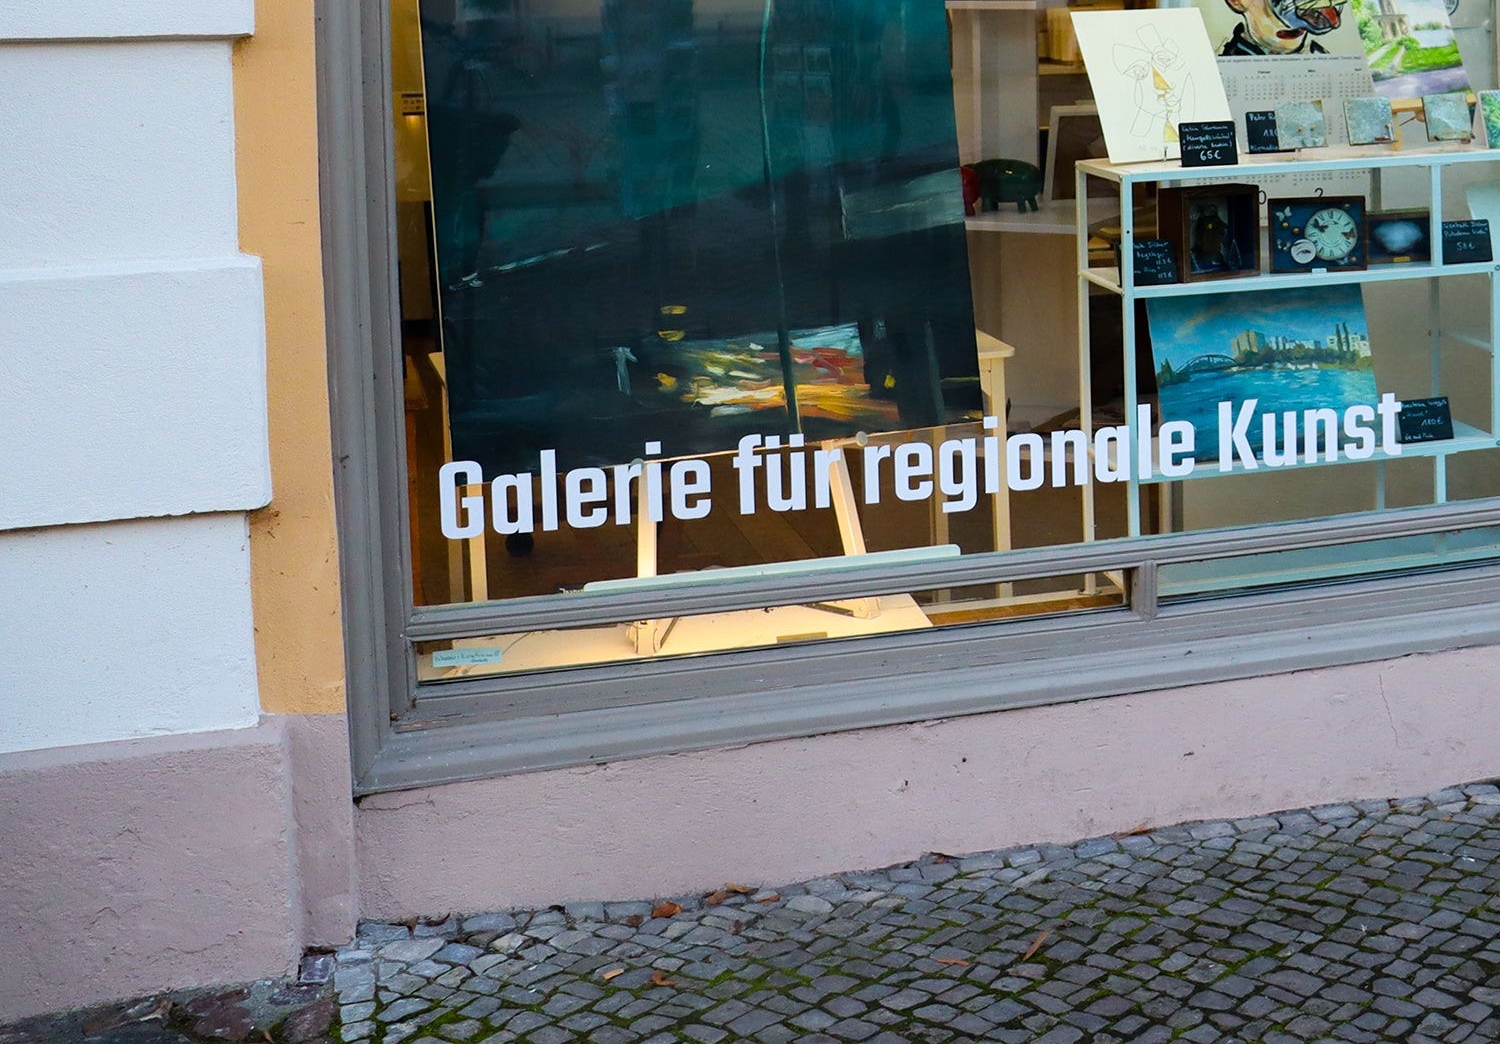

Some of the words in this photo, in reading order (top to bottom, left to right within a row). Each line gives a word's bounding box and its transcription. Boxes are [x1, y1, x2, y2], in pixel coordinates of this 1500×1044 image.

[1200, 150, 1222, 161] 65€
[439, 441, 712, 540] Galerie
[732, 433, 842, 515] für
[864, 404, 1195, 513] regionale
[1218, 392, 1403, 472] Kunst
